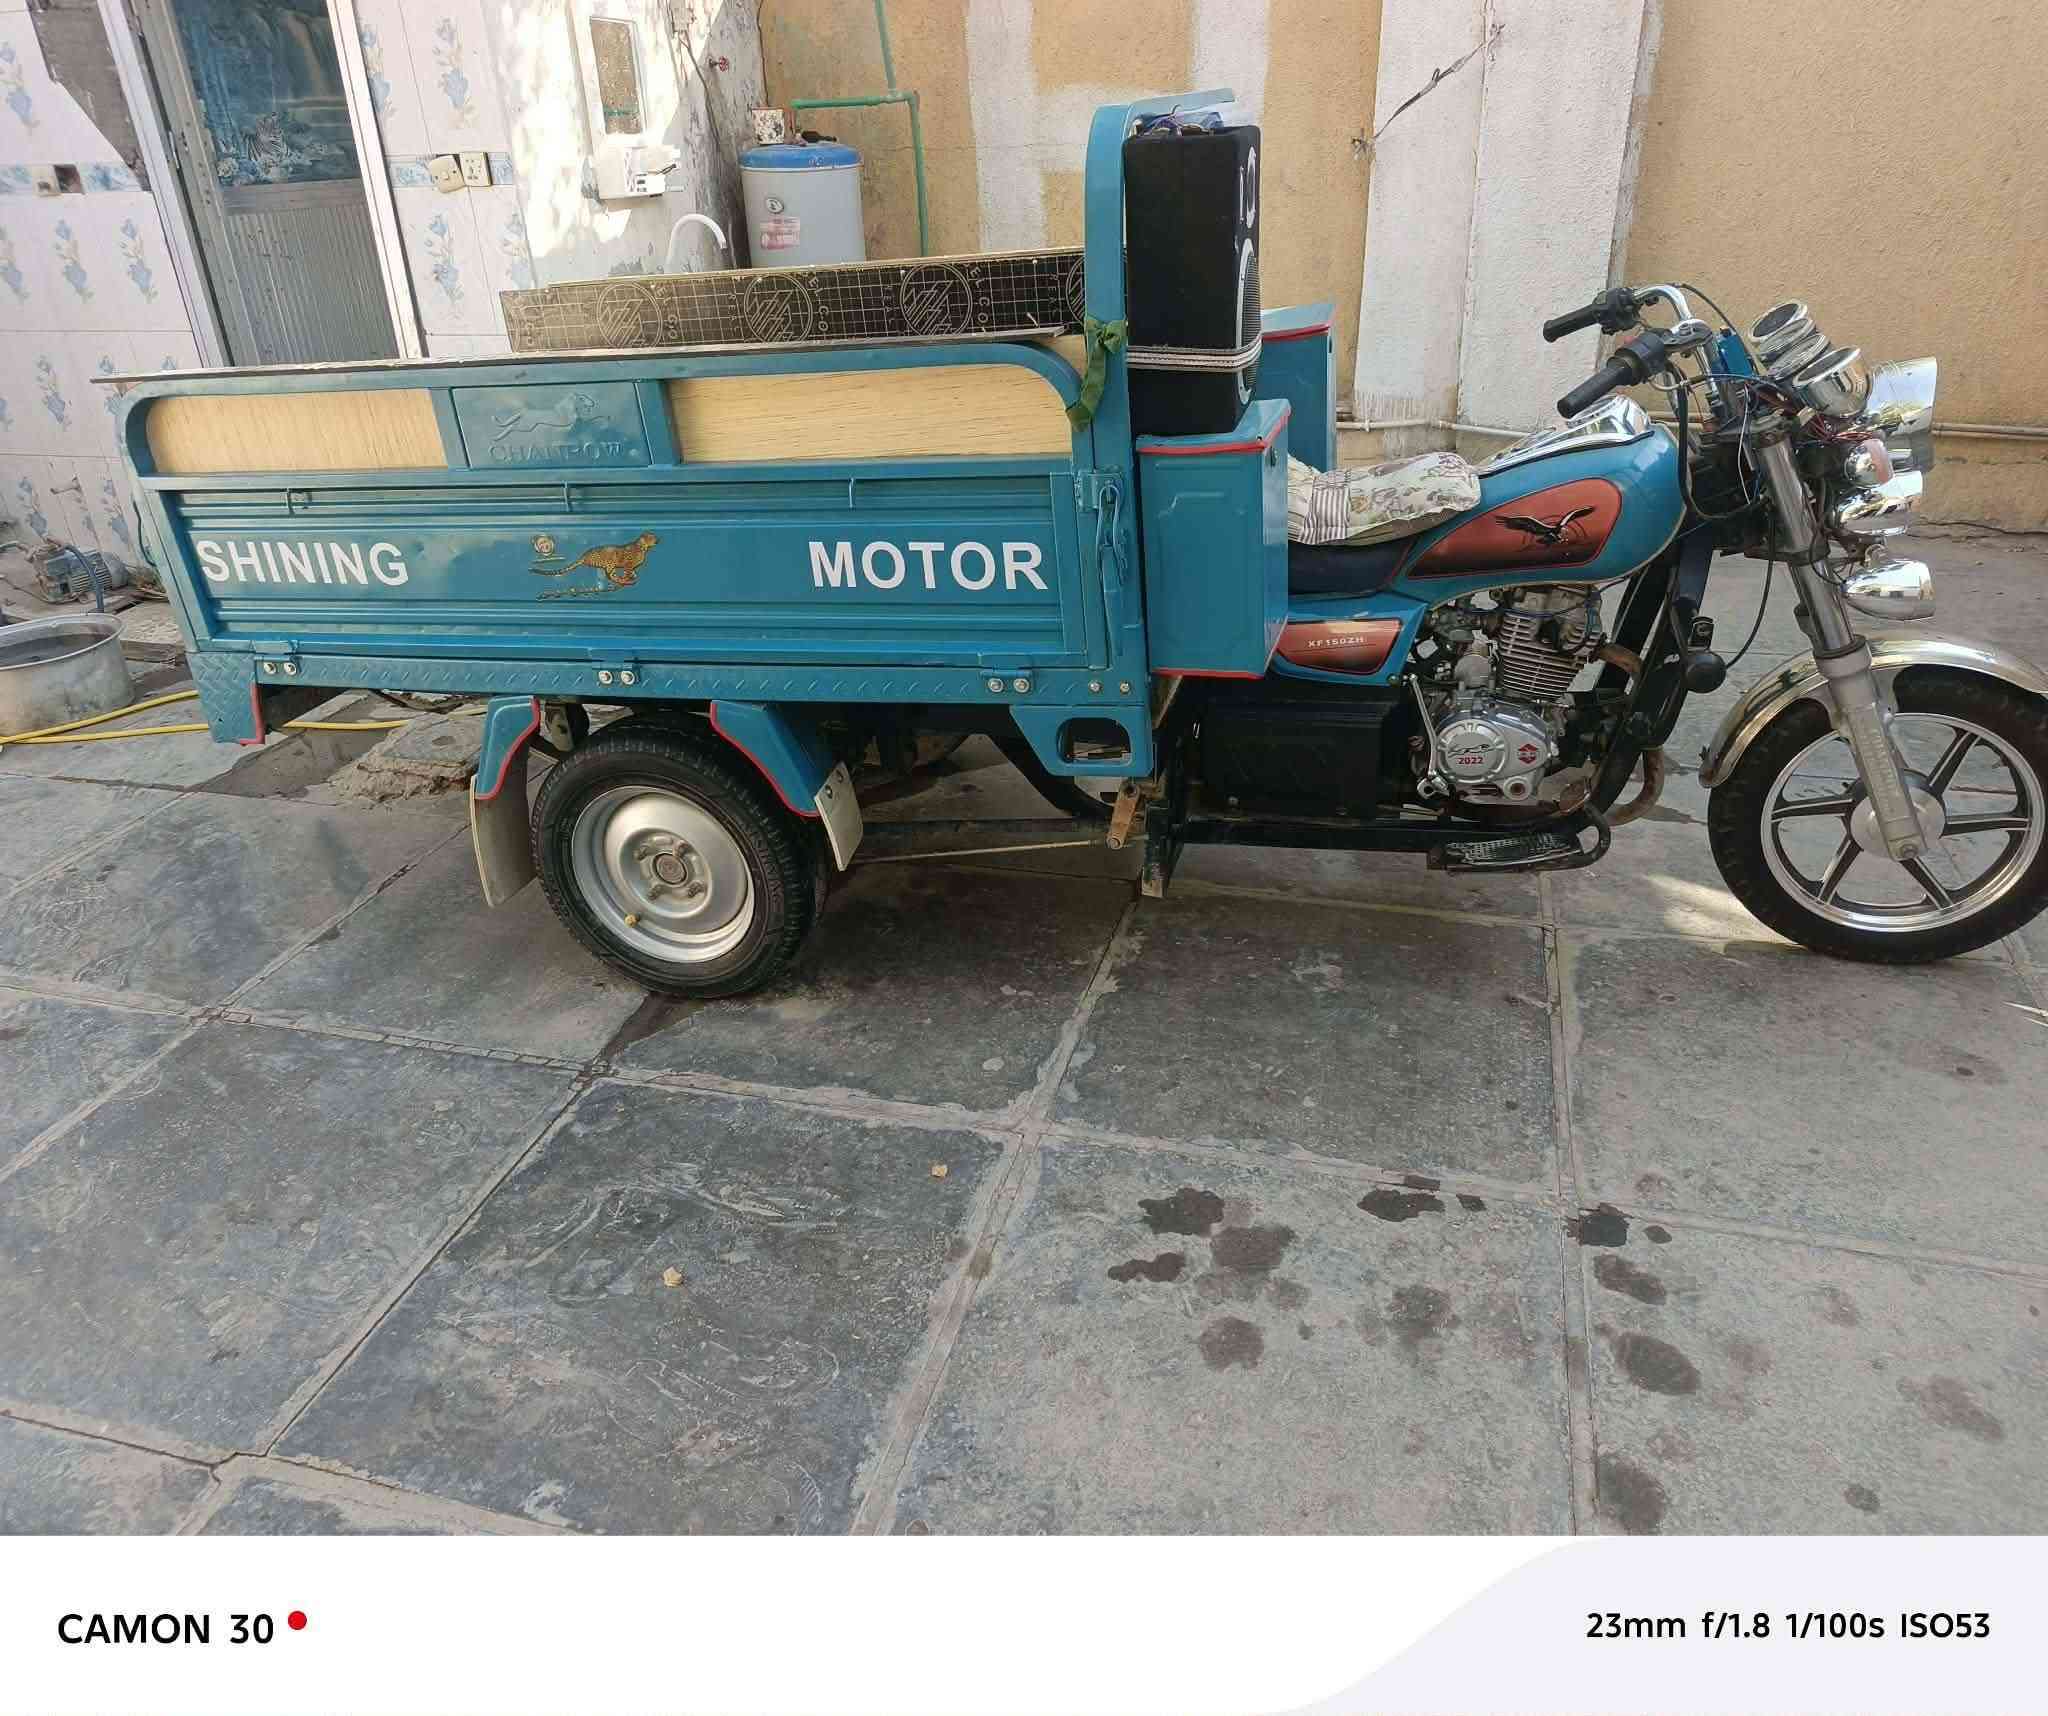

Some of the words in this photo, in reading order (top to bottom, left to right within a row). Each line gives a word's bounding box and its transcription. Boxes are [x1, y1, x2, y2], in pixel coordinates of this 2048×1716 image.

[196, 540, 409, 586] SHINING
[808, 541, 1048, 590] MOTOR
[1457, 756, 1484, 765] 2022
